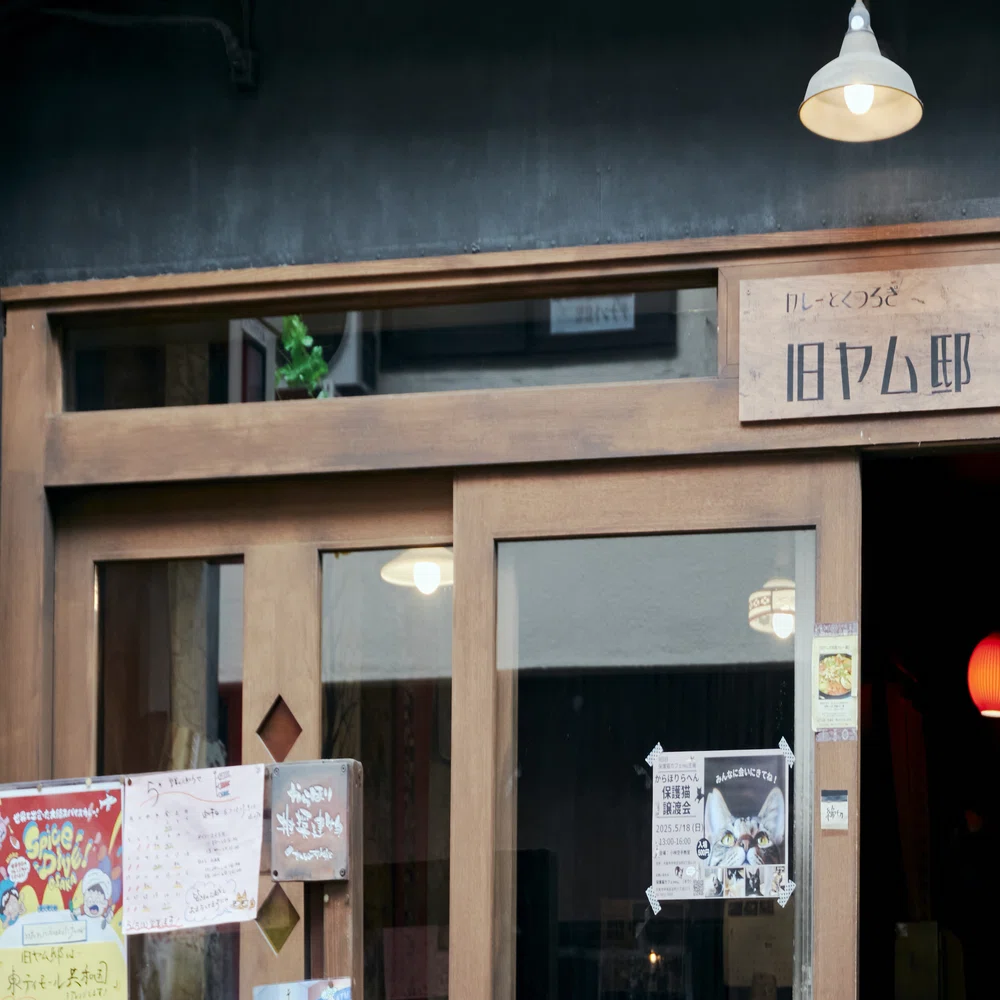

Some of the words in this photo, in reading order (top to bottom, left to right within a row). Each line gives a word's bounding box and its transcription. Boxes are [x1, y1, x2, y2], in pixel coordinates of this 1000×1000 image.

[786, 332, 971, 402] 旧ヤム邸
[655, 773, 699, 784] からほりらへん
[662, 785, 691, 799] 保護猫
[662, 801, 691, 815] 譲渡会
[659, 837, 691, 846] 13:00-16:00
